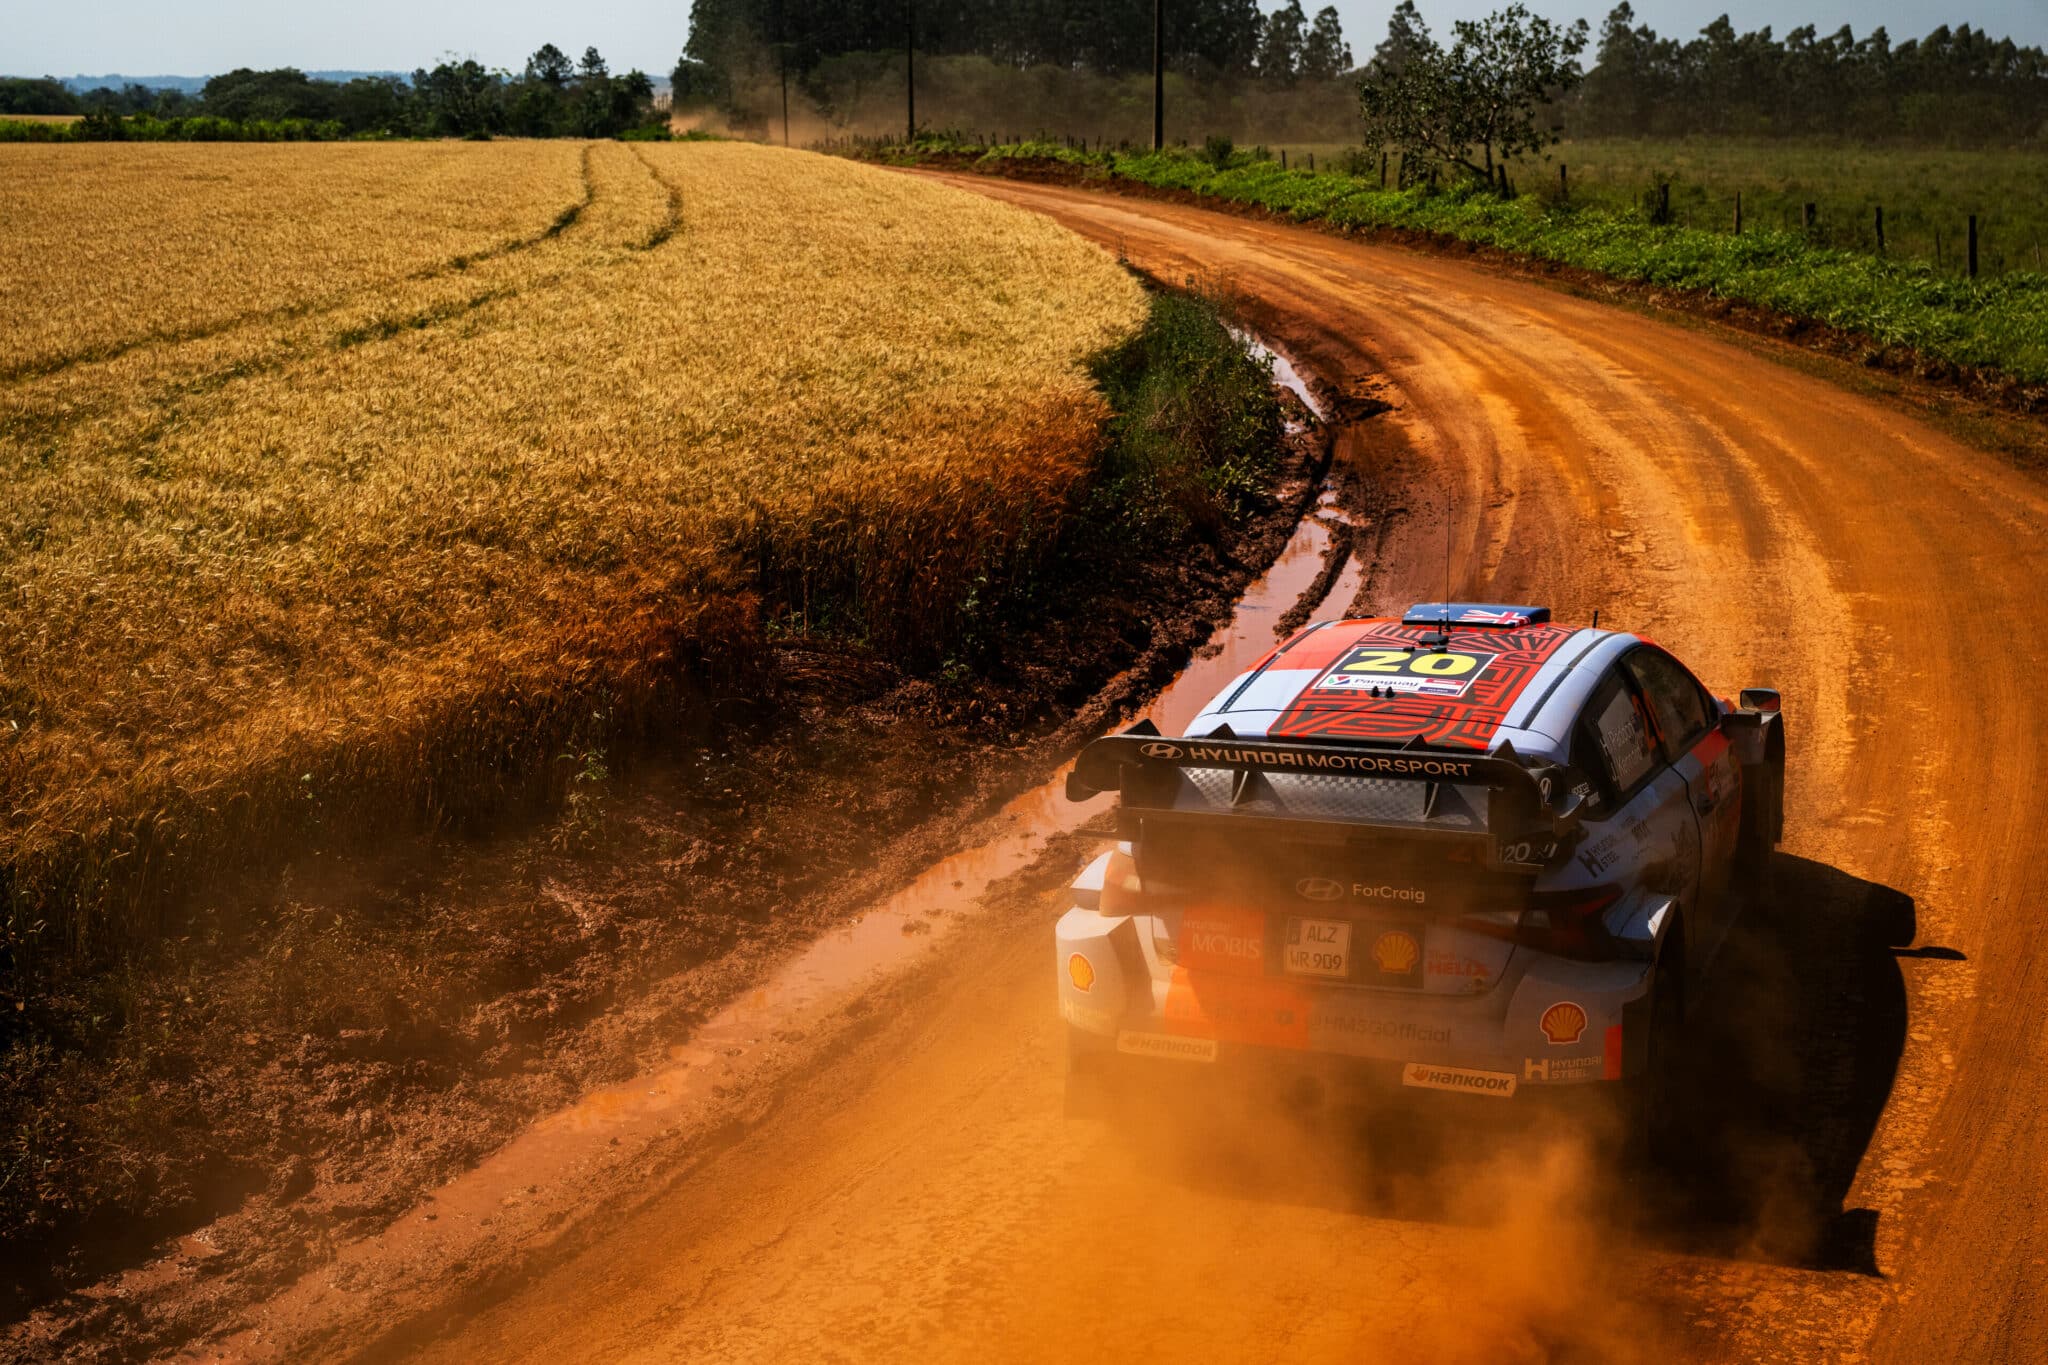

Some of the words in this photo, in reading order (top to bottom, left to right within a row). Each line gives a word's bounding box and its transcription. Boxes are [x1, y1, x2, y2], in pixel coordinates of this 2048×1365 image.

[1342, 651, 1477, 676] 20
[1354, 679, 1419, 688] Paraguay
[1190, 747, 1302, 767] HYUNDAI
[1308, 754, 1472, 777] MOTORSPORT
[1352, 883, 1425, 903] ForCraig
[1307, 926, 1337, 944] ALZ
[1192, 931, 1261, 960] MOBIS
[1290, 950, 1311, 969] WR
[1428, 1071, 1513, 1091] Hankook
